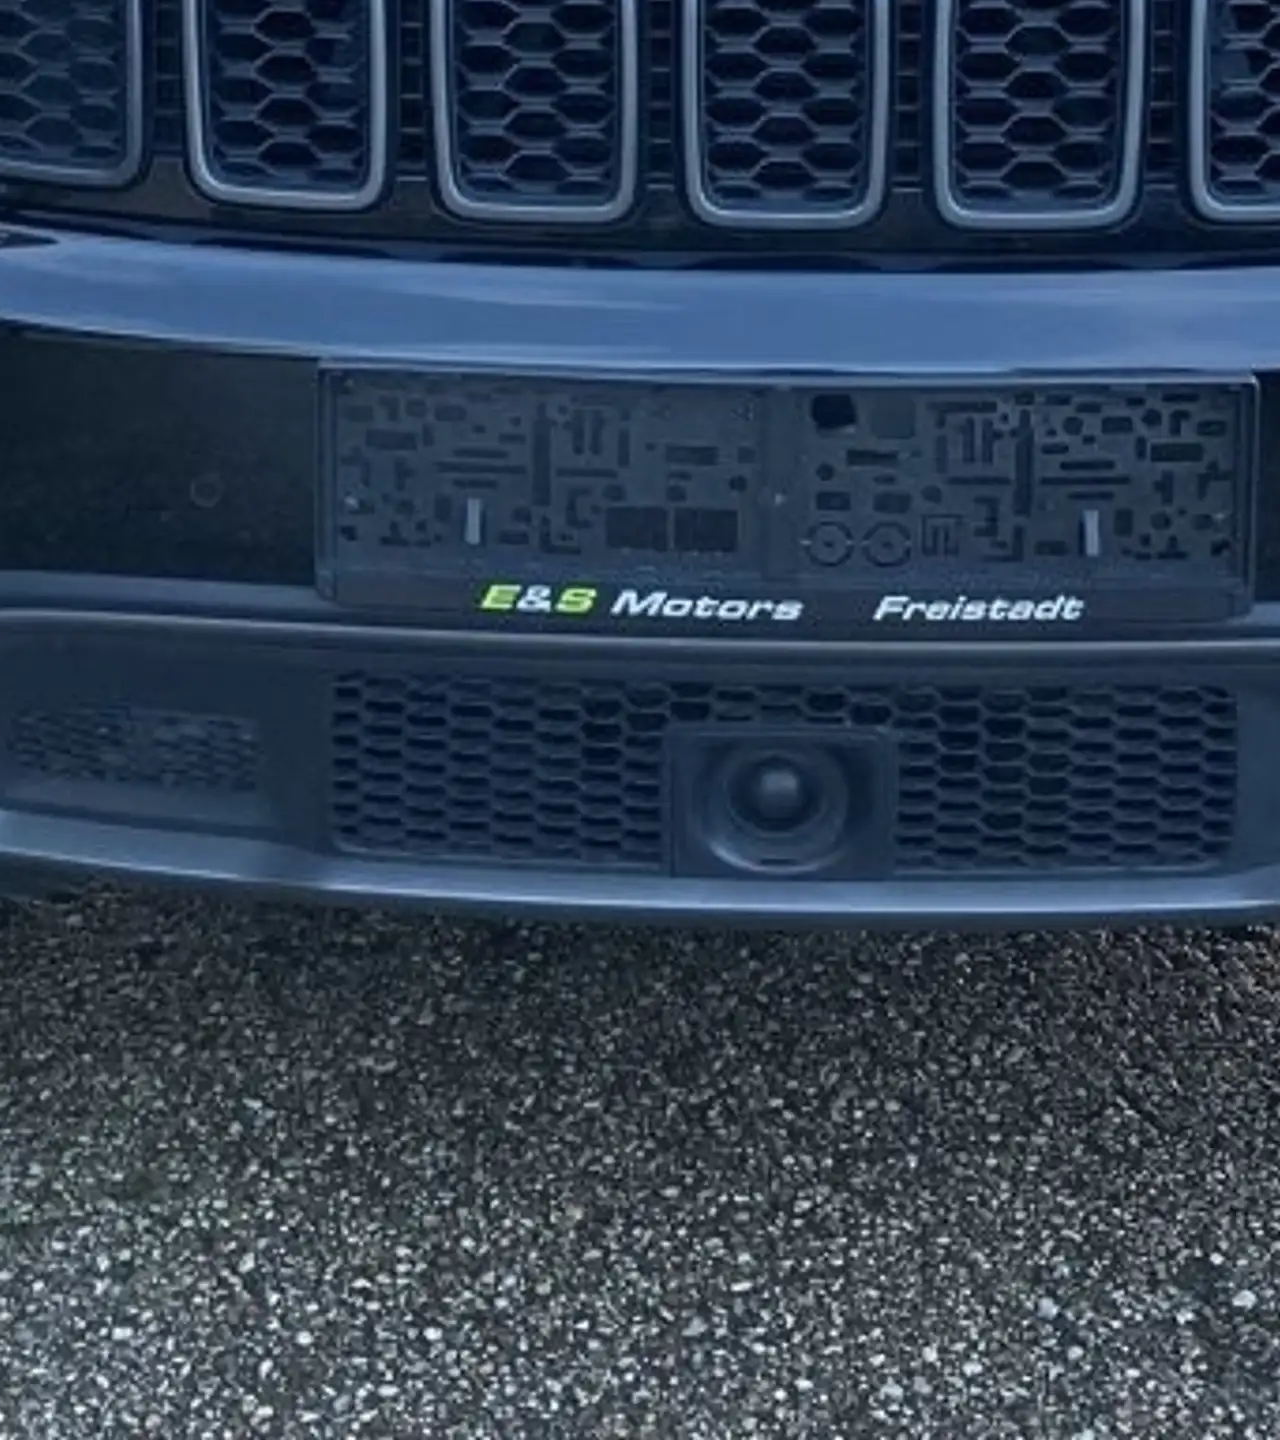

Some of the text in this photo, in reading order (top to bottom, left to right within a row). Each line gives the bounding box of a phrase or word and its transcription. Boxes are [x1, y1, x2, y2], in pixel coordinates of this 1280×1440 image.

[481, 583, 1086, 622] E&S Motors Freistadt
